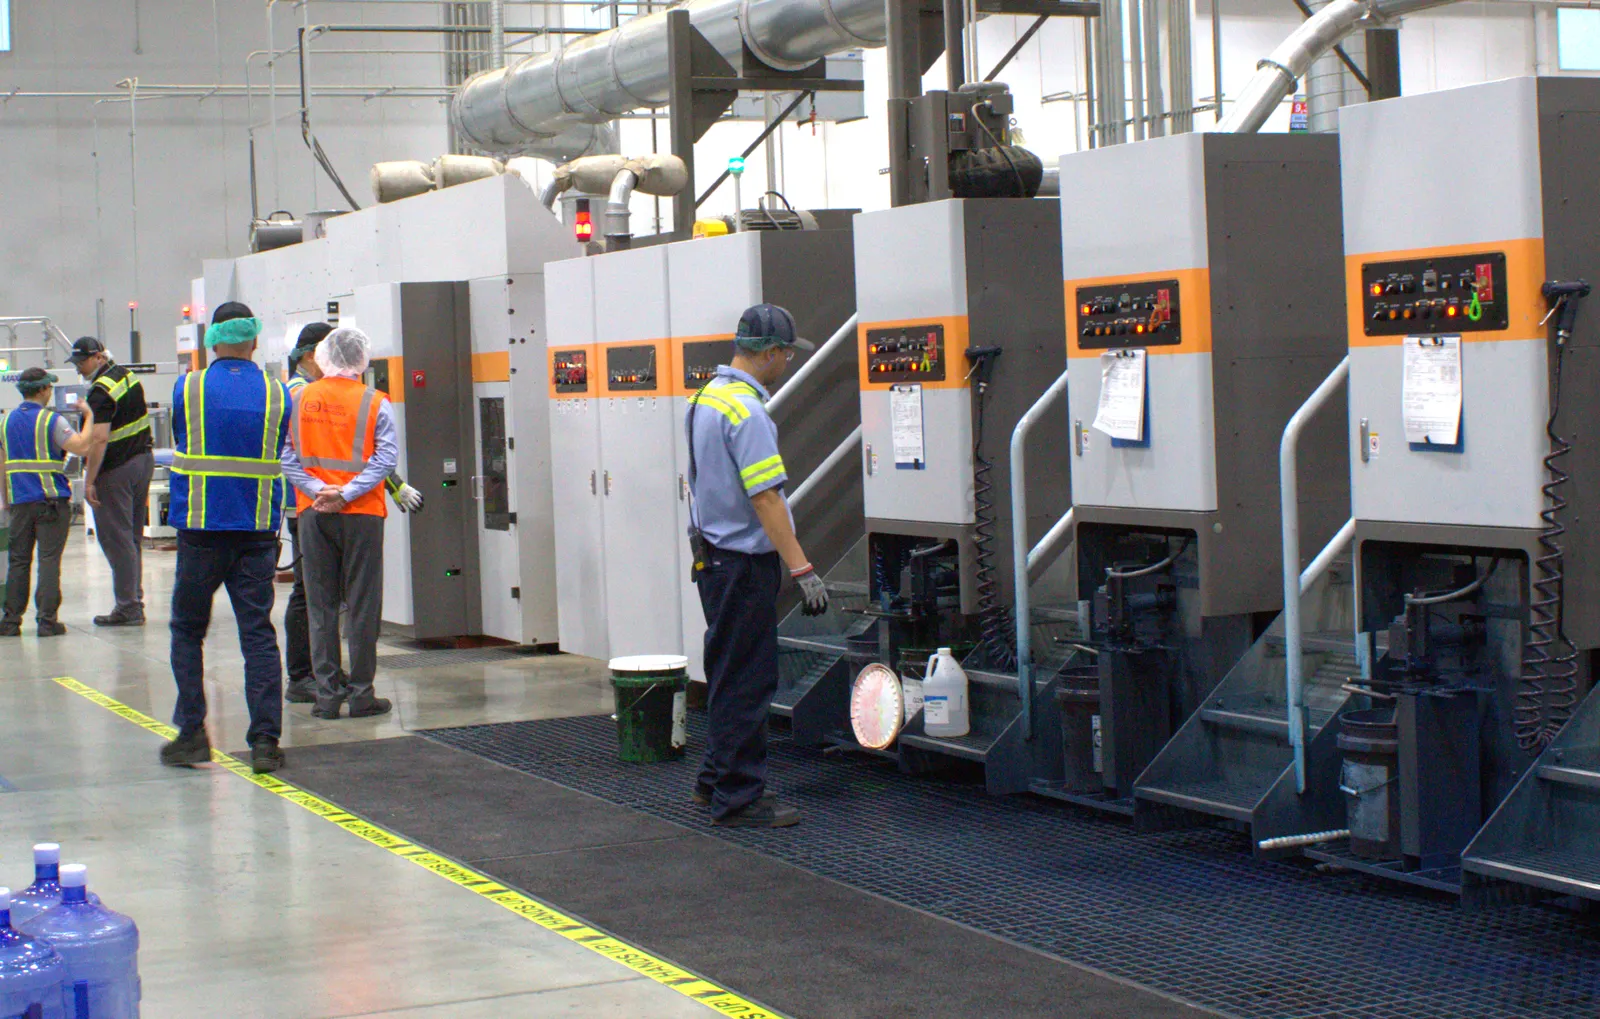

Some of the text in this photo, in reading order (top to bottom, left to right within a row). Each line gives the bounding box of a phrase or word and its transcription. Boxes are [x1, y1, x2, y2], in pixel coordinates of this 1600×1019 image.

[428, 863, 477, 881] HANDS
[513, 904, 568, 925] HANDS
[615, 953, 679, 978] HANDS
